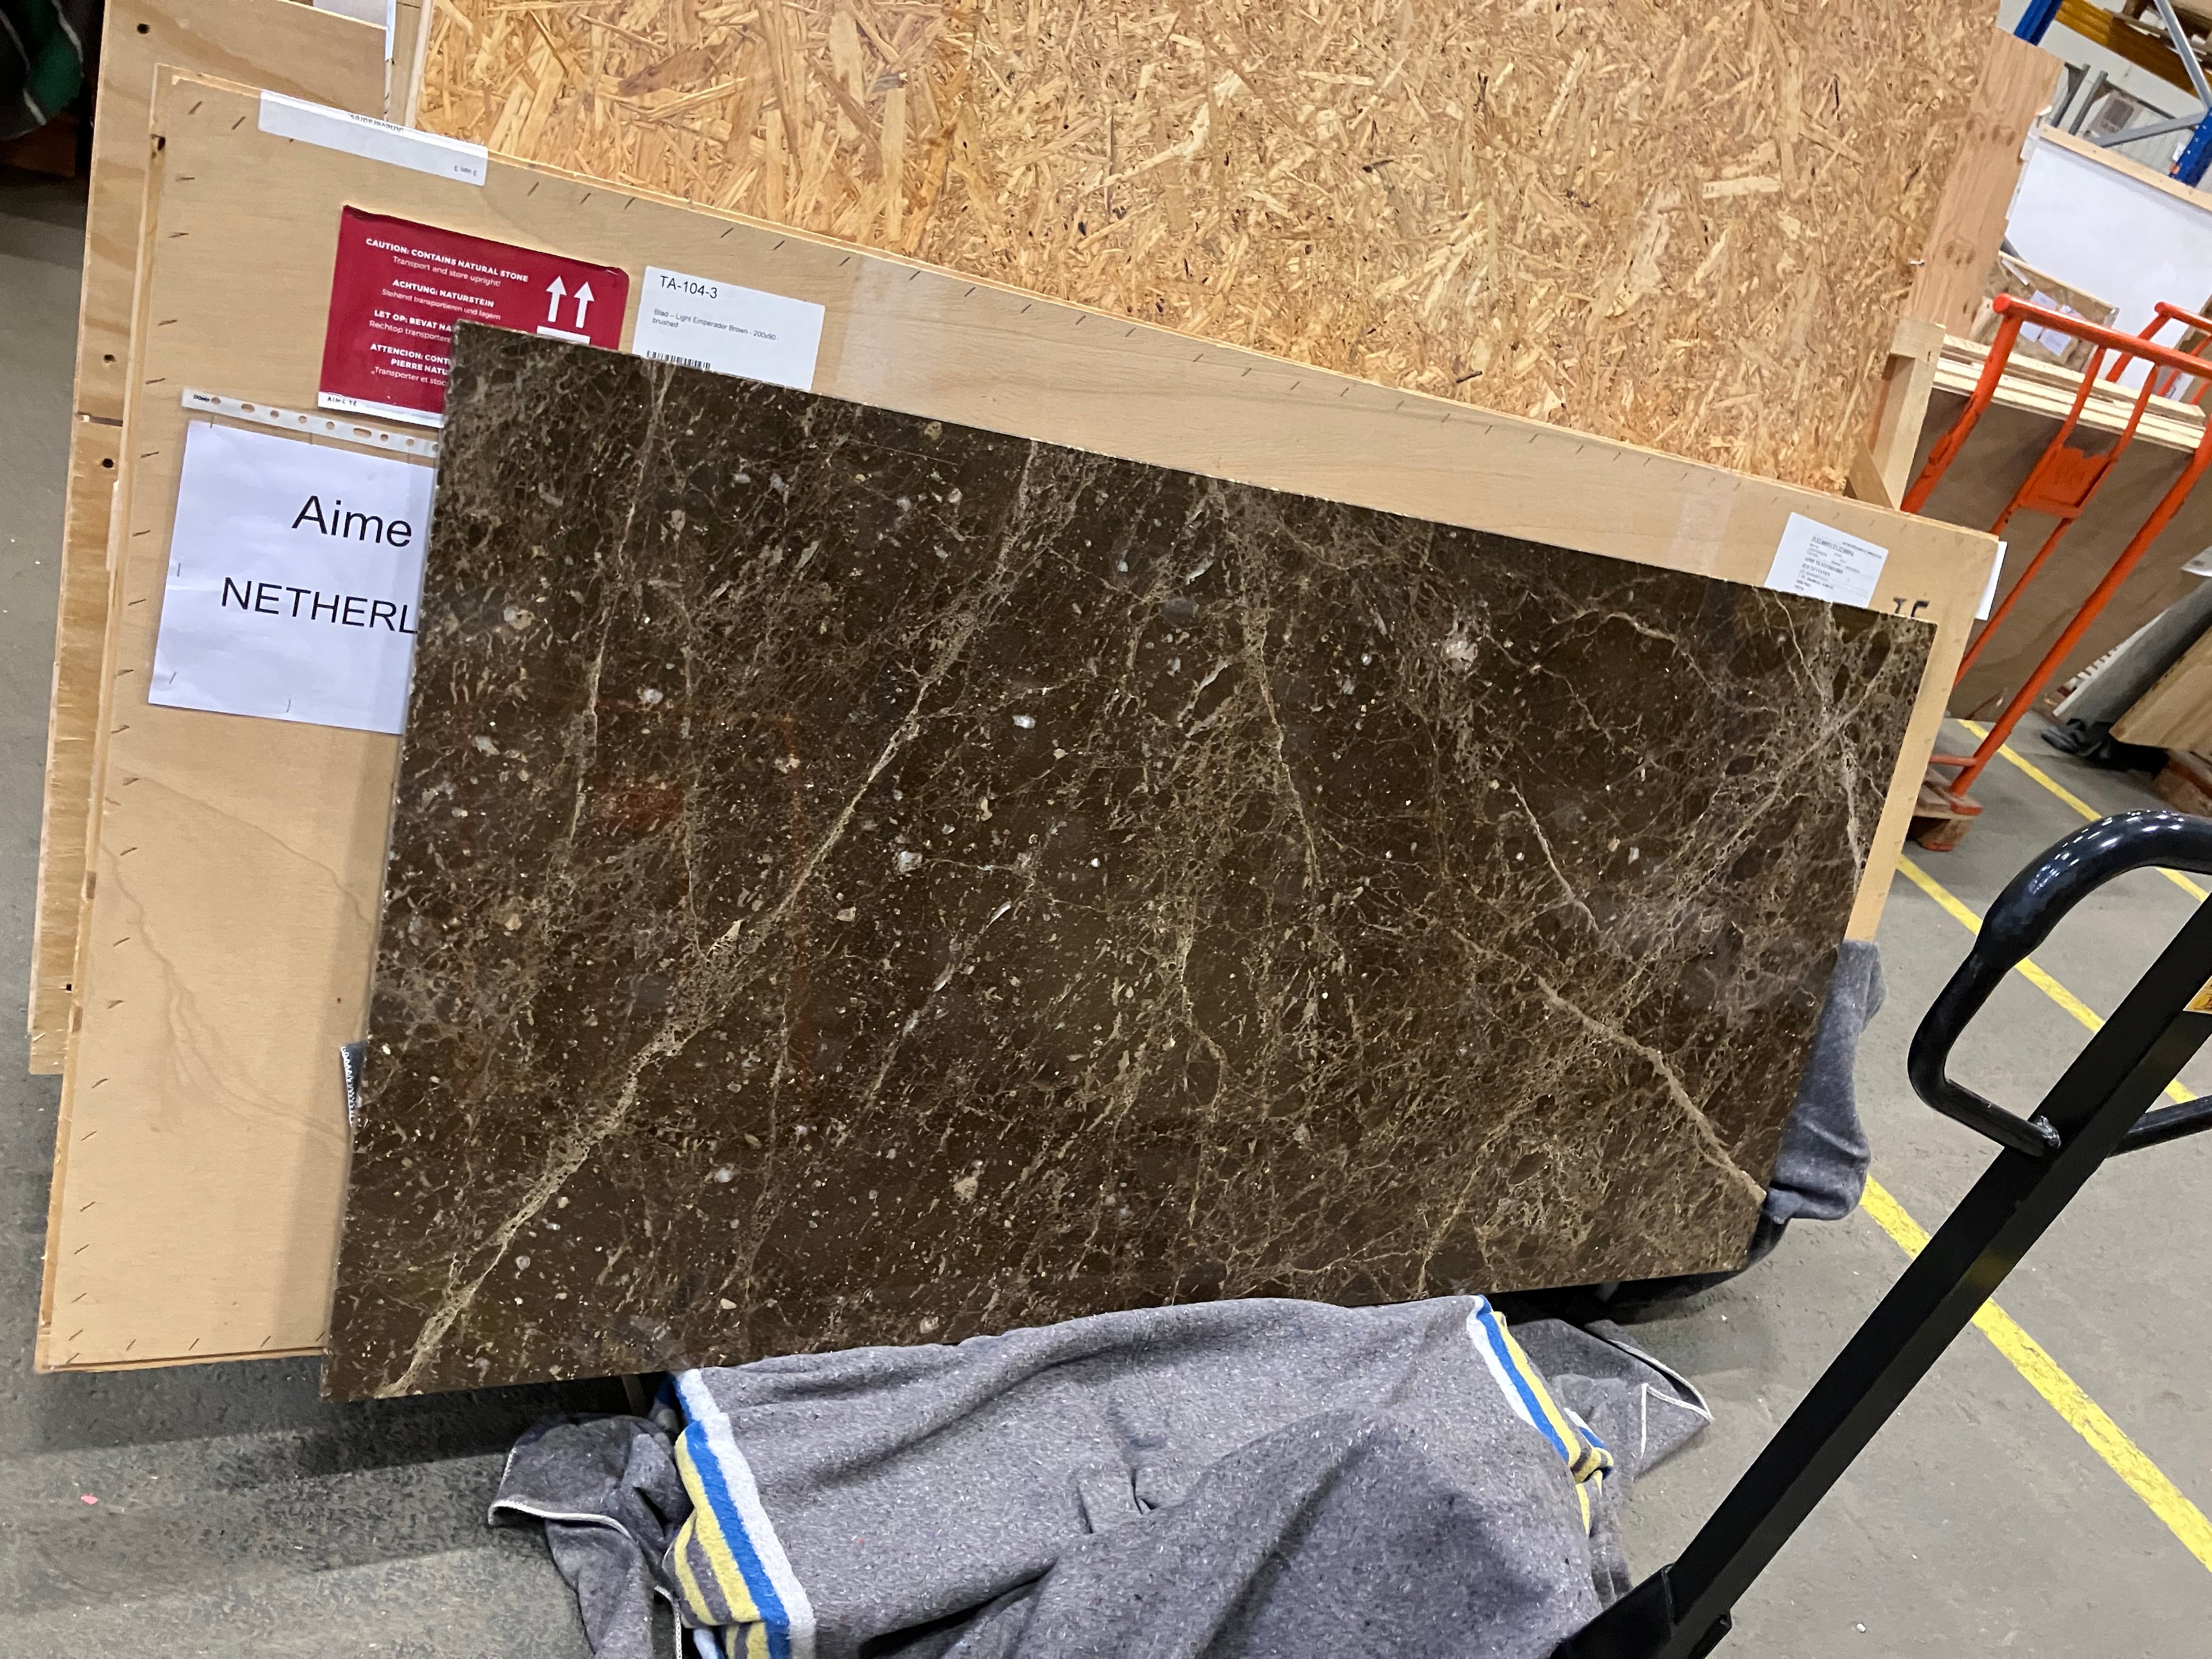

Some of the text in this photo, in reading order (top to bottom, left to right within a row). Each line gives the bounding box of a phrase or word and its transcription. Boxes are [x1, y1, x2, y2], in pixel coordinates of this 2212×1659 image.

[366, 237, 529, 282] CAUTION: CONTAINS NATURAL STONE
[394, 256, 501, 287] Transport and store upright!
[392, 279, 494, 307] ACHTUNG: NATURSTEIN
[660, 275, 718, 299] TA-104-3
[382, 289, 501, 320] Stehend transportieren und lagern
[369, 320, 403, 334] Rechtop
[374, 309, 391, 319] LET
[392, 313, 407, 323] OP:
[409, 317, 438, 329] BEVAT
[653, 317, 678, 328] brushed
[676, 313, 692, 322] Light
[693, 317, 727, 329] Emperador
[729, 325, 748, 334] Brown
[753, 330, 777, 341] 200x90
[370, 343, 423, 360] ATTENCION:
[375, 366, 419, 381] Transporter
[391, 358, 423, 371] PIERRE
[292, 495, 412, 547] Aime
